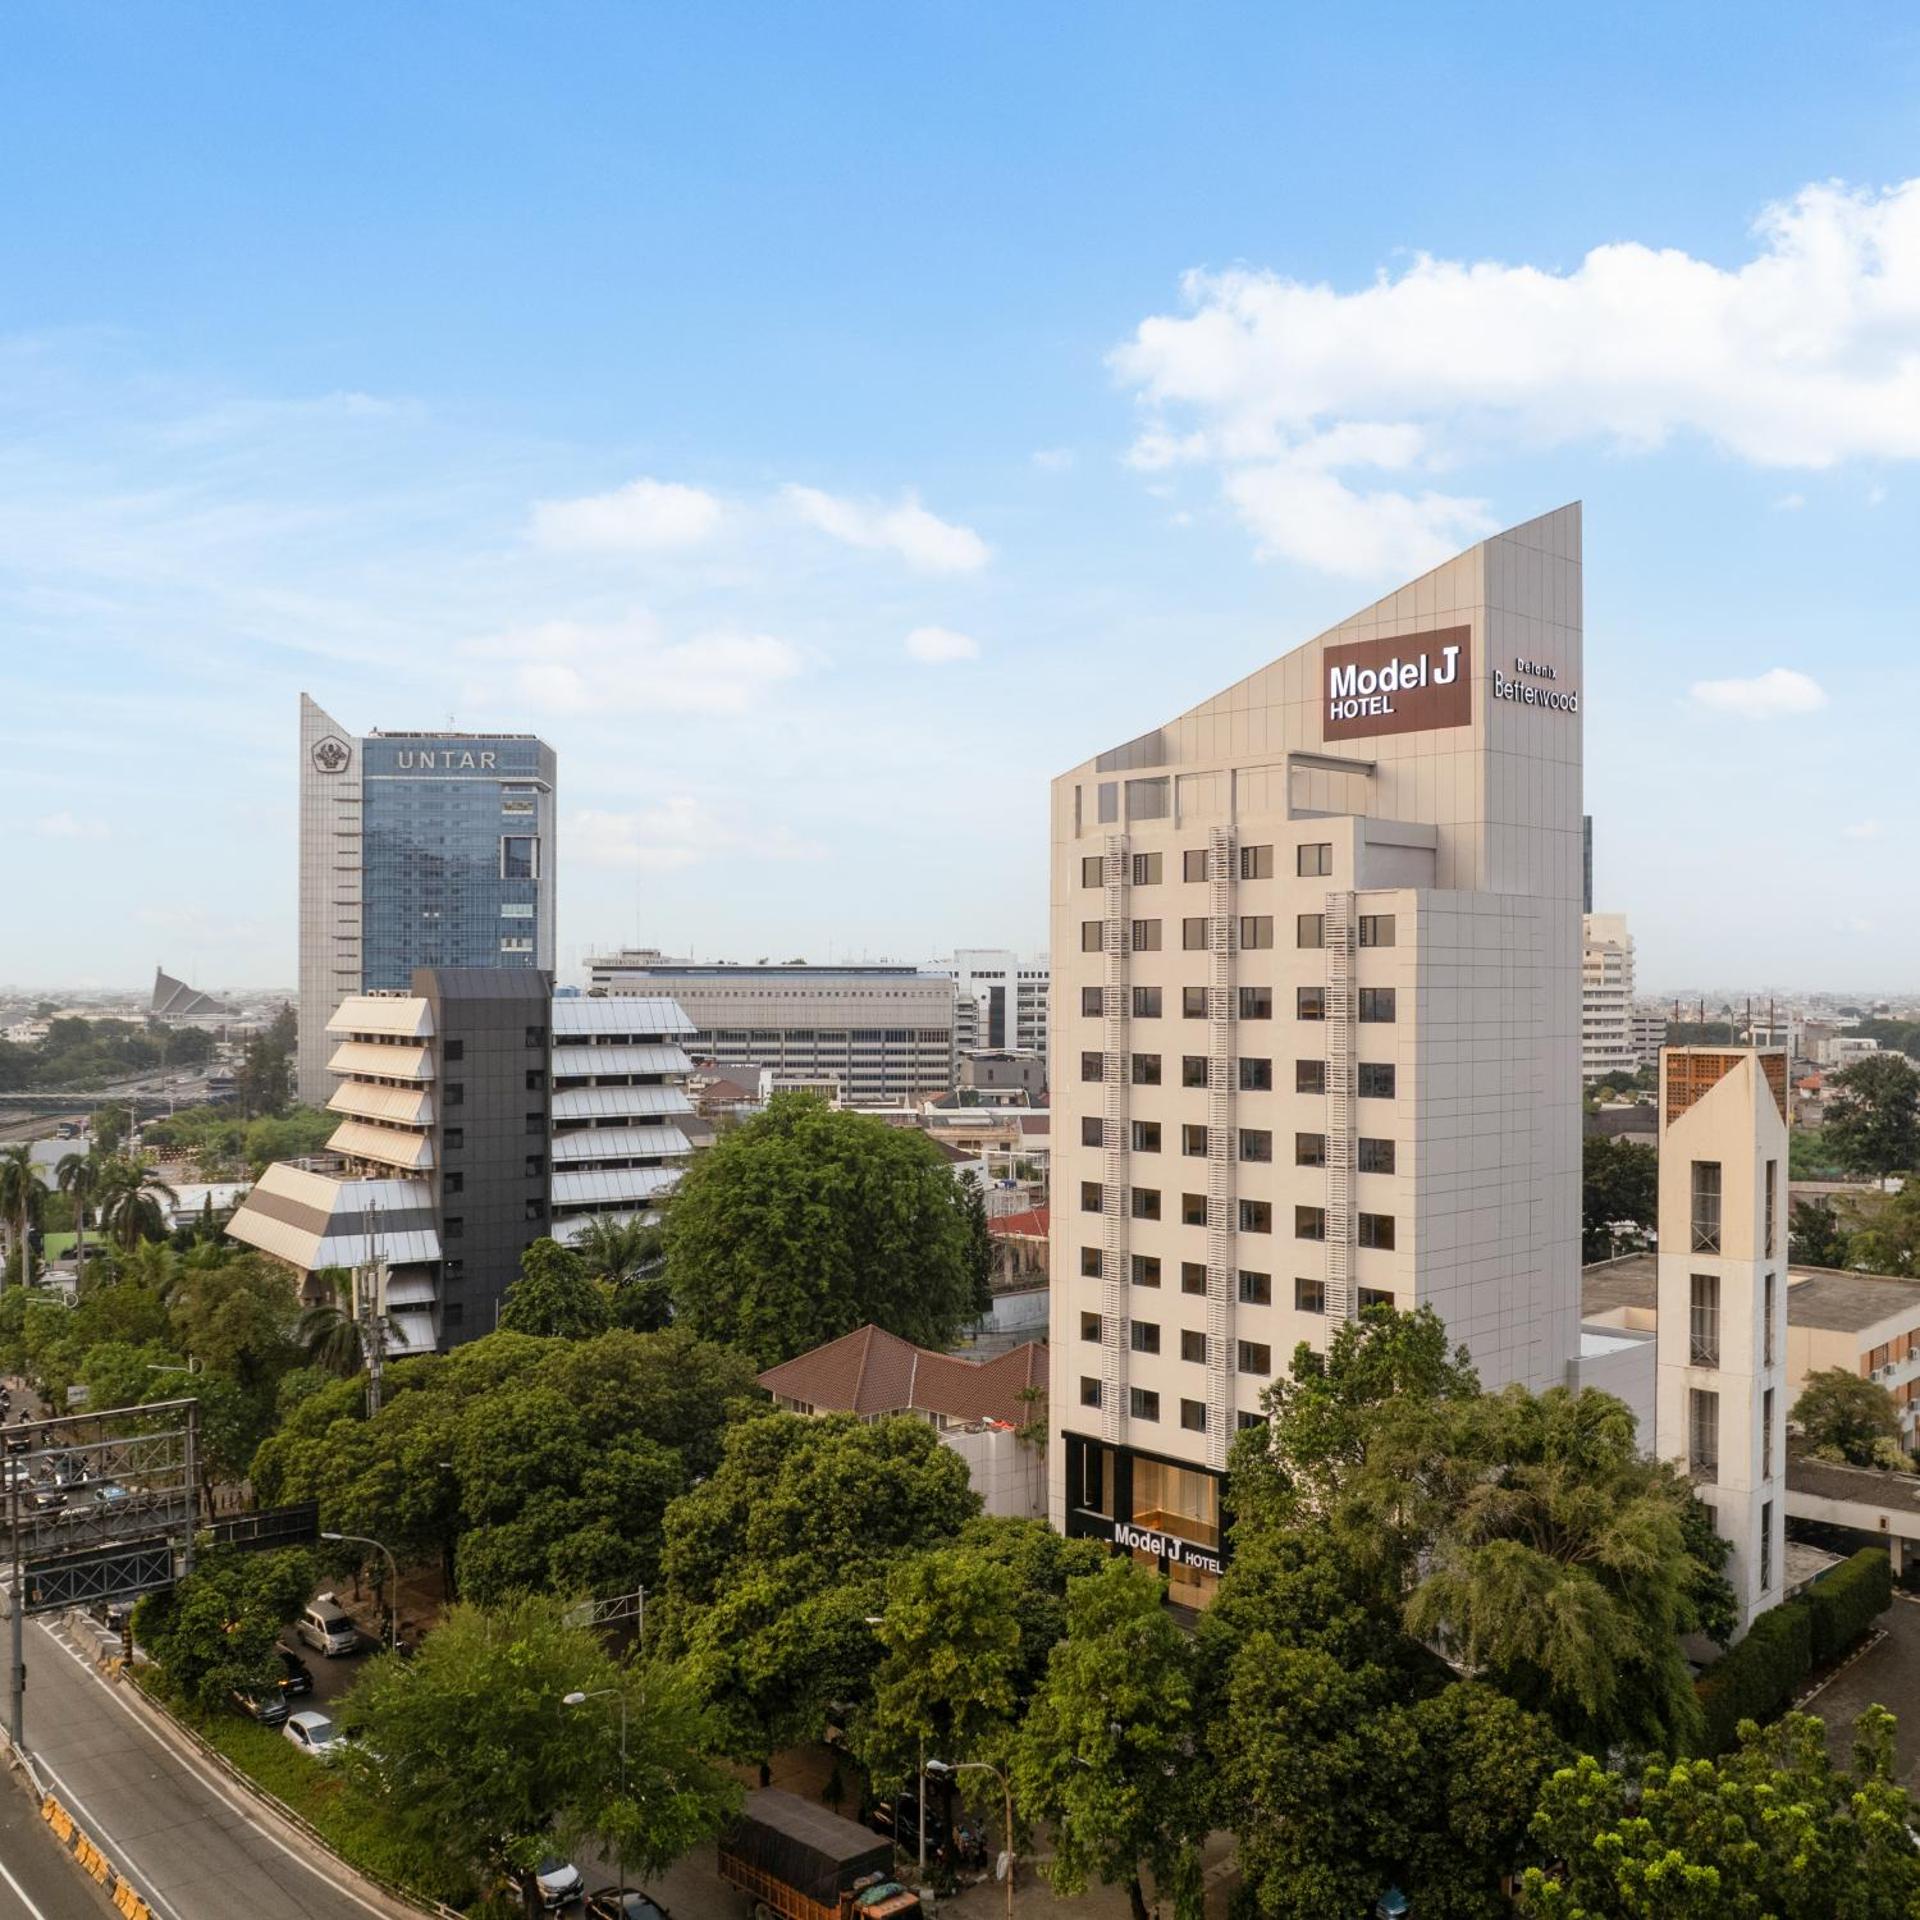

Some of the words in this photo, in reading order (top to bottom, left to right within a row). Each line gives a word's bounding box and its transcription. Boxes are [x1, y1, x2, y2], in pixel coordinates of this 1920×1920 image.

[1330, 654, 1427, 698] Model
[1434, 646, 1461, 684] J
[1516, 657, 1557, 680] Delonix
[1331, 695, 1395, 720] HOTEL
[1494, 669, 1578, 712] Betterwood
[398, 751, 496, 769] UNTAR
[1115, 1523, 1165, 1556] Model
[1168, 1539, 1182, 1560] J
[1185, 1552, 1224, 1574] HOTEL
